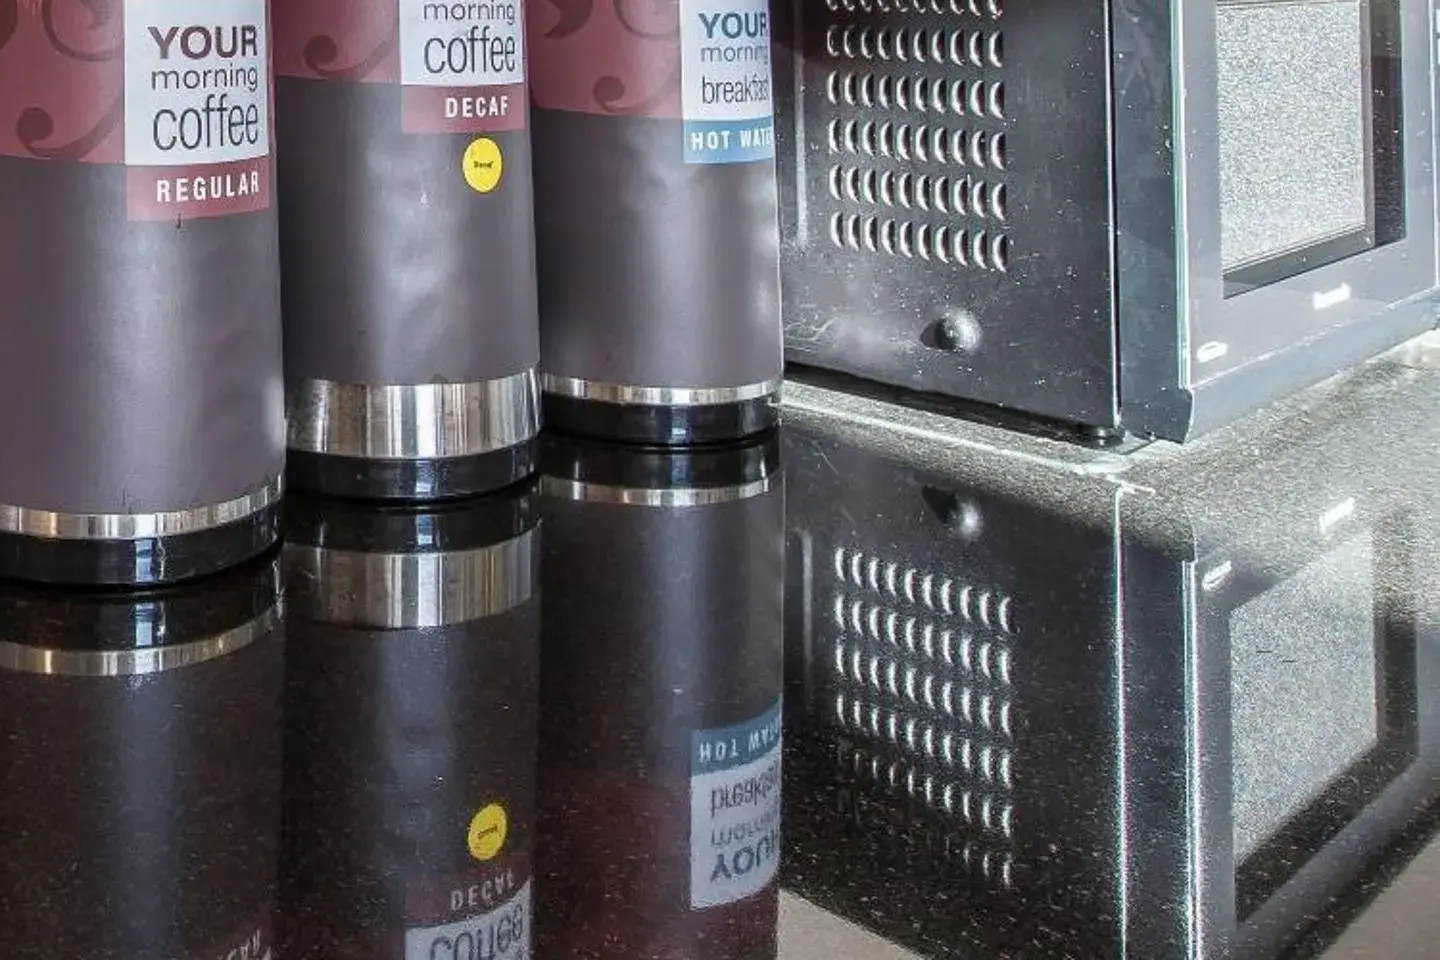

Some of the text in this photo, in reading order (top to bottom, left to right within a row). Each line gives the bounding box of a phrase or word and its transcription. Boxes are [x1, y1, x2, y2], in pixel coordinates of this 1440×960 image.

[423, 0, 516, 25] morning
[148, 25, 258, 60] YOUR
[424, 26, 516, 74] coffee
[151, 64, 259, 91] morning
[445, 96, 509, 119] DECAF
[153, 94, 259, 151] coffee
[690, 130, 730, 151] HOT
[157, 171, 260, 202] REGULAR
